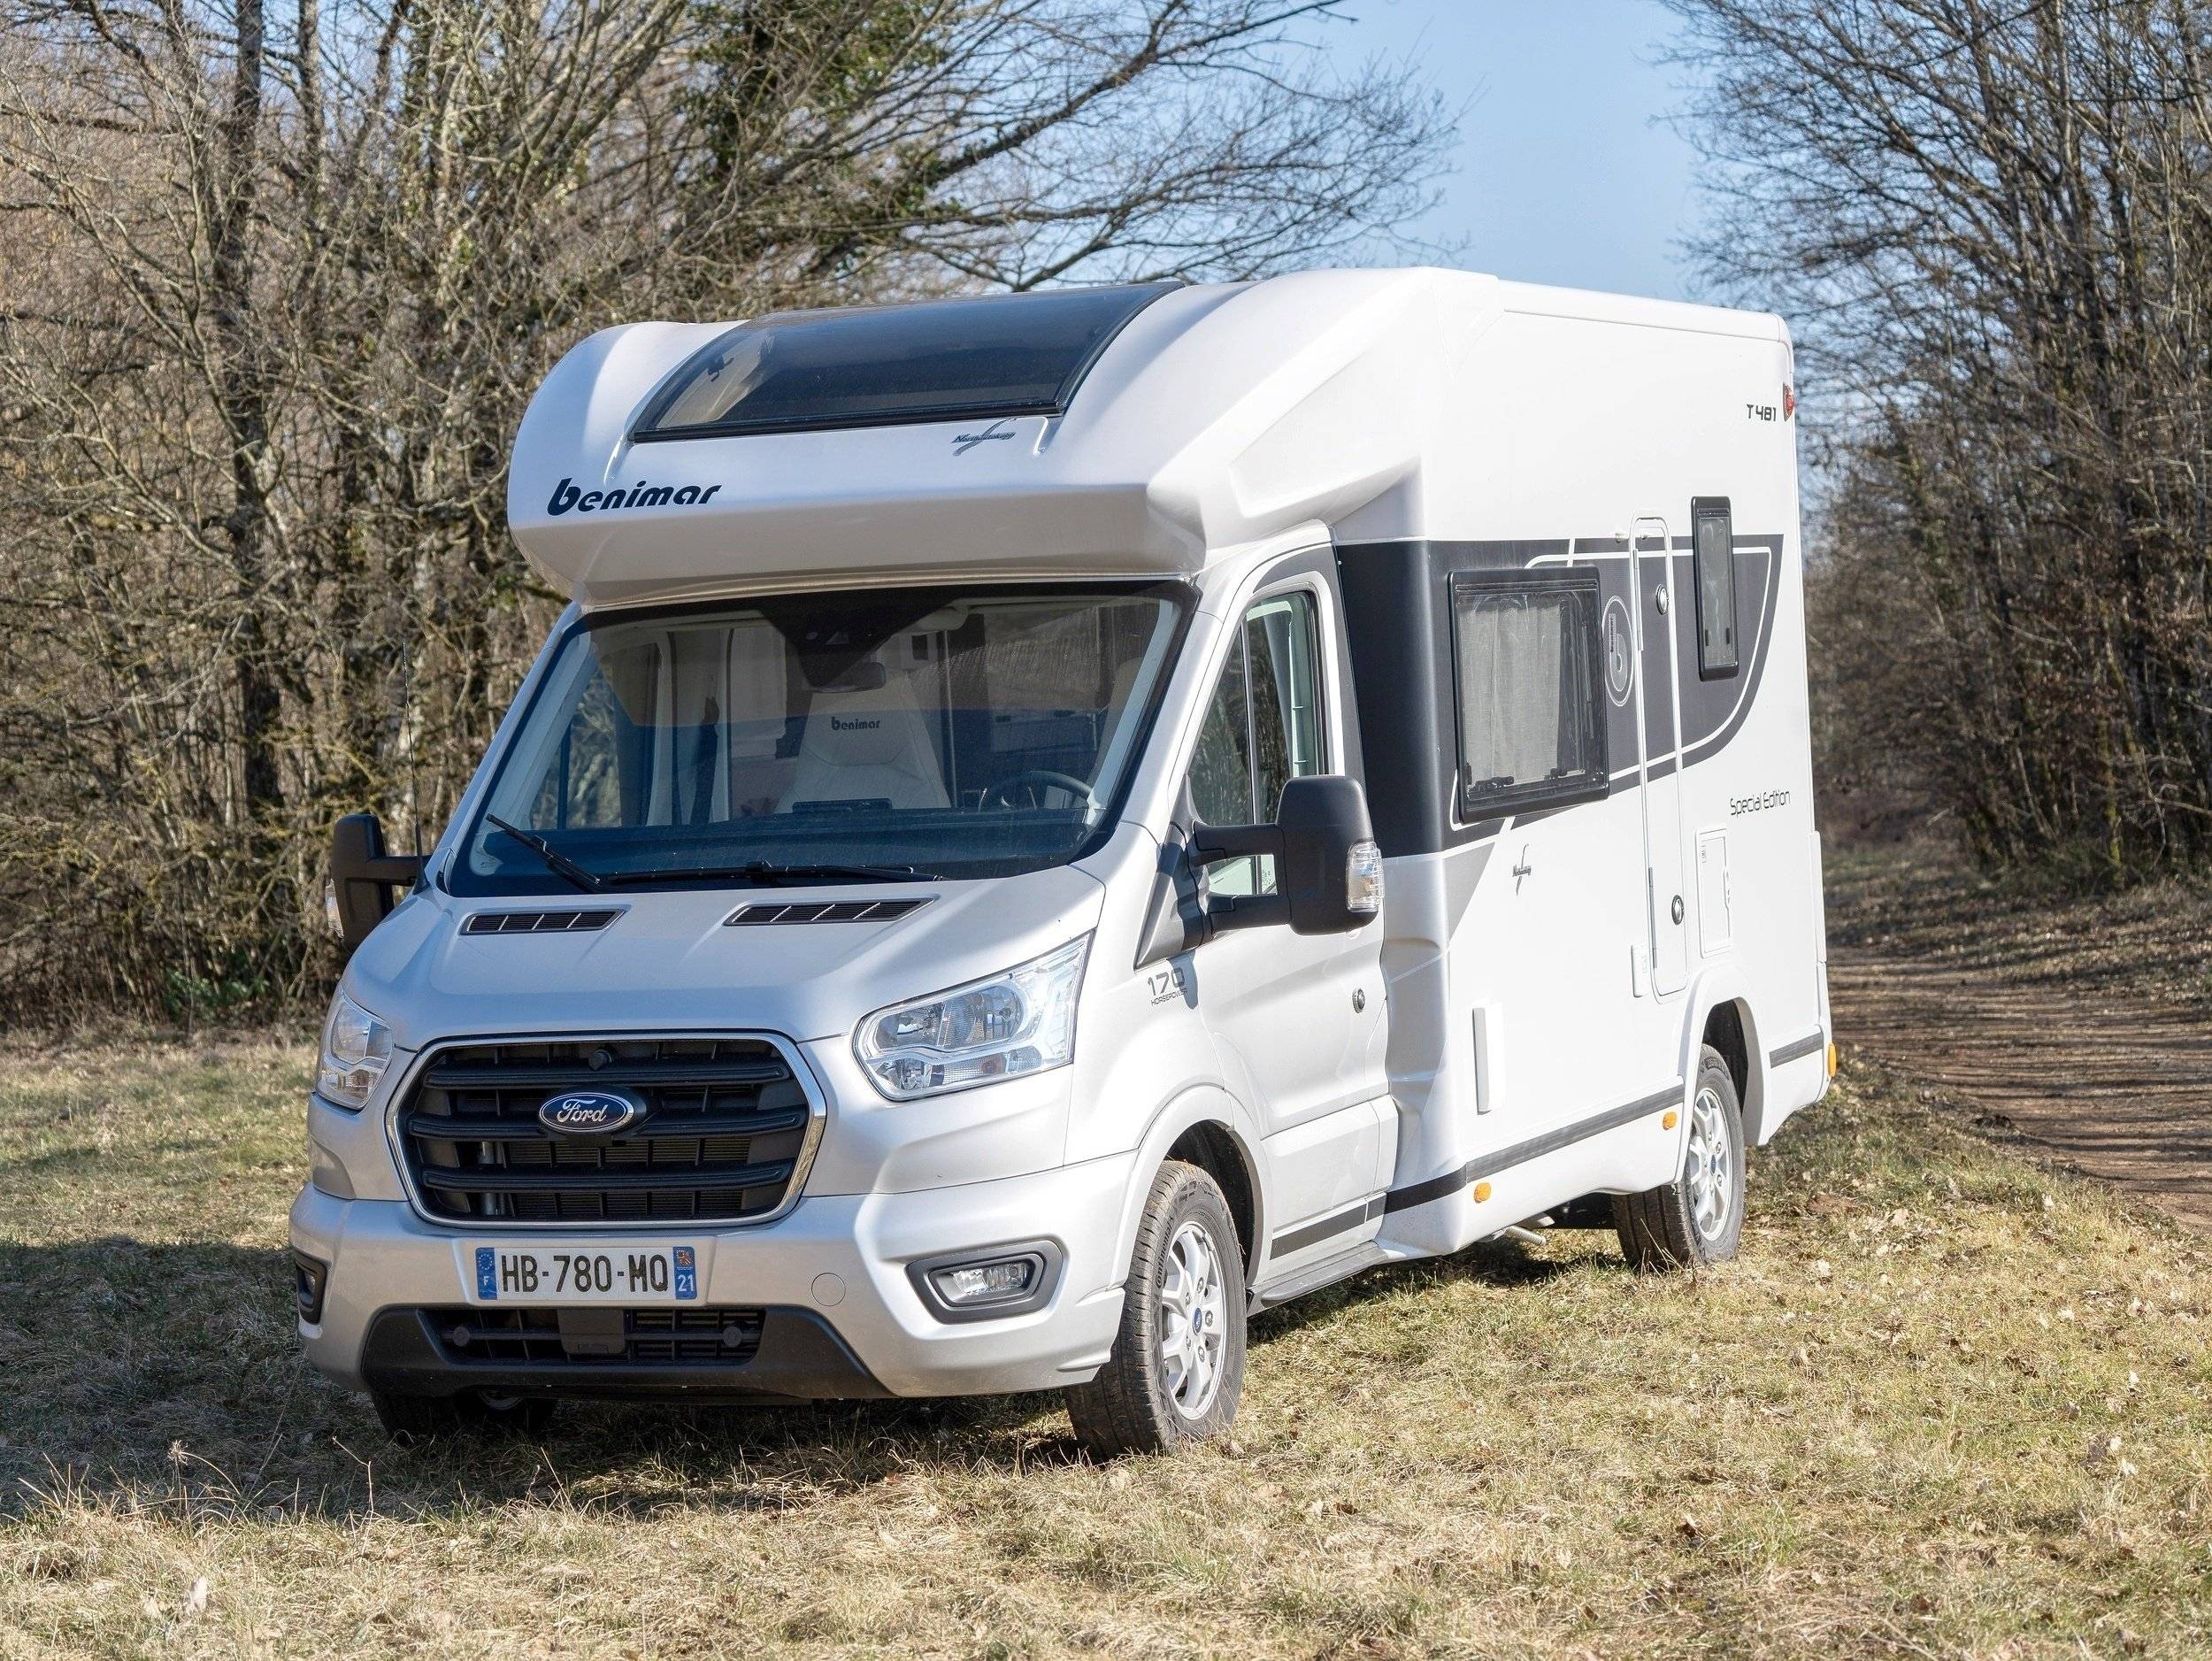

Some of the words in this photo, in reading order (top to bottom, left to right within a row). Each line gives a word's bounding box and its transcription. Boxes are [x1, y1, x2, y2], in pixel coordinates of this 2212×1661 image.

[547, 477, 723, 516] benimar
[831, 716, 880, 731] benimar
[1730, 794, 1763, 819] Special
[1763, 788, 1791, 810] Edition
[1148, 967, 1186, 996] 170
[1151, 987, 1190, 1007] HORSEPOWER
[557, 1098, 609, 1123] Ford
[483, 1275, 489, 1287] F
[501, 1254, 669, 1293] HB-780-MQ
[677, 1273, 695, 1292] 21
